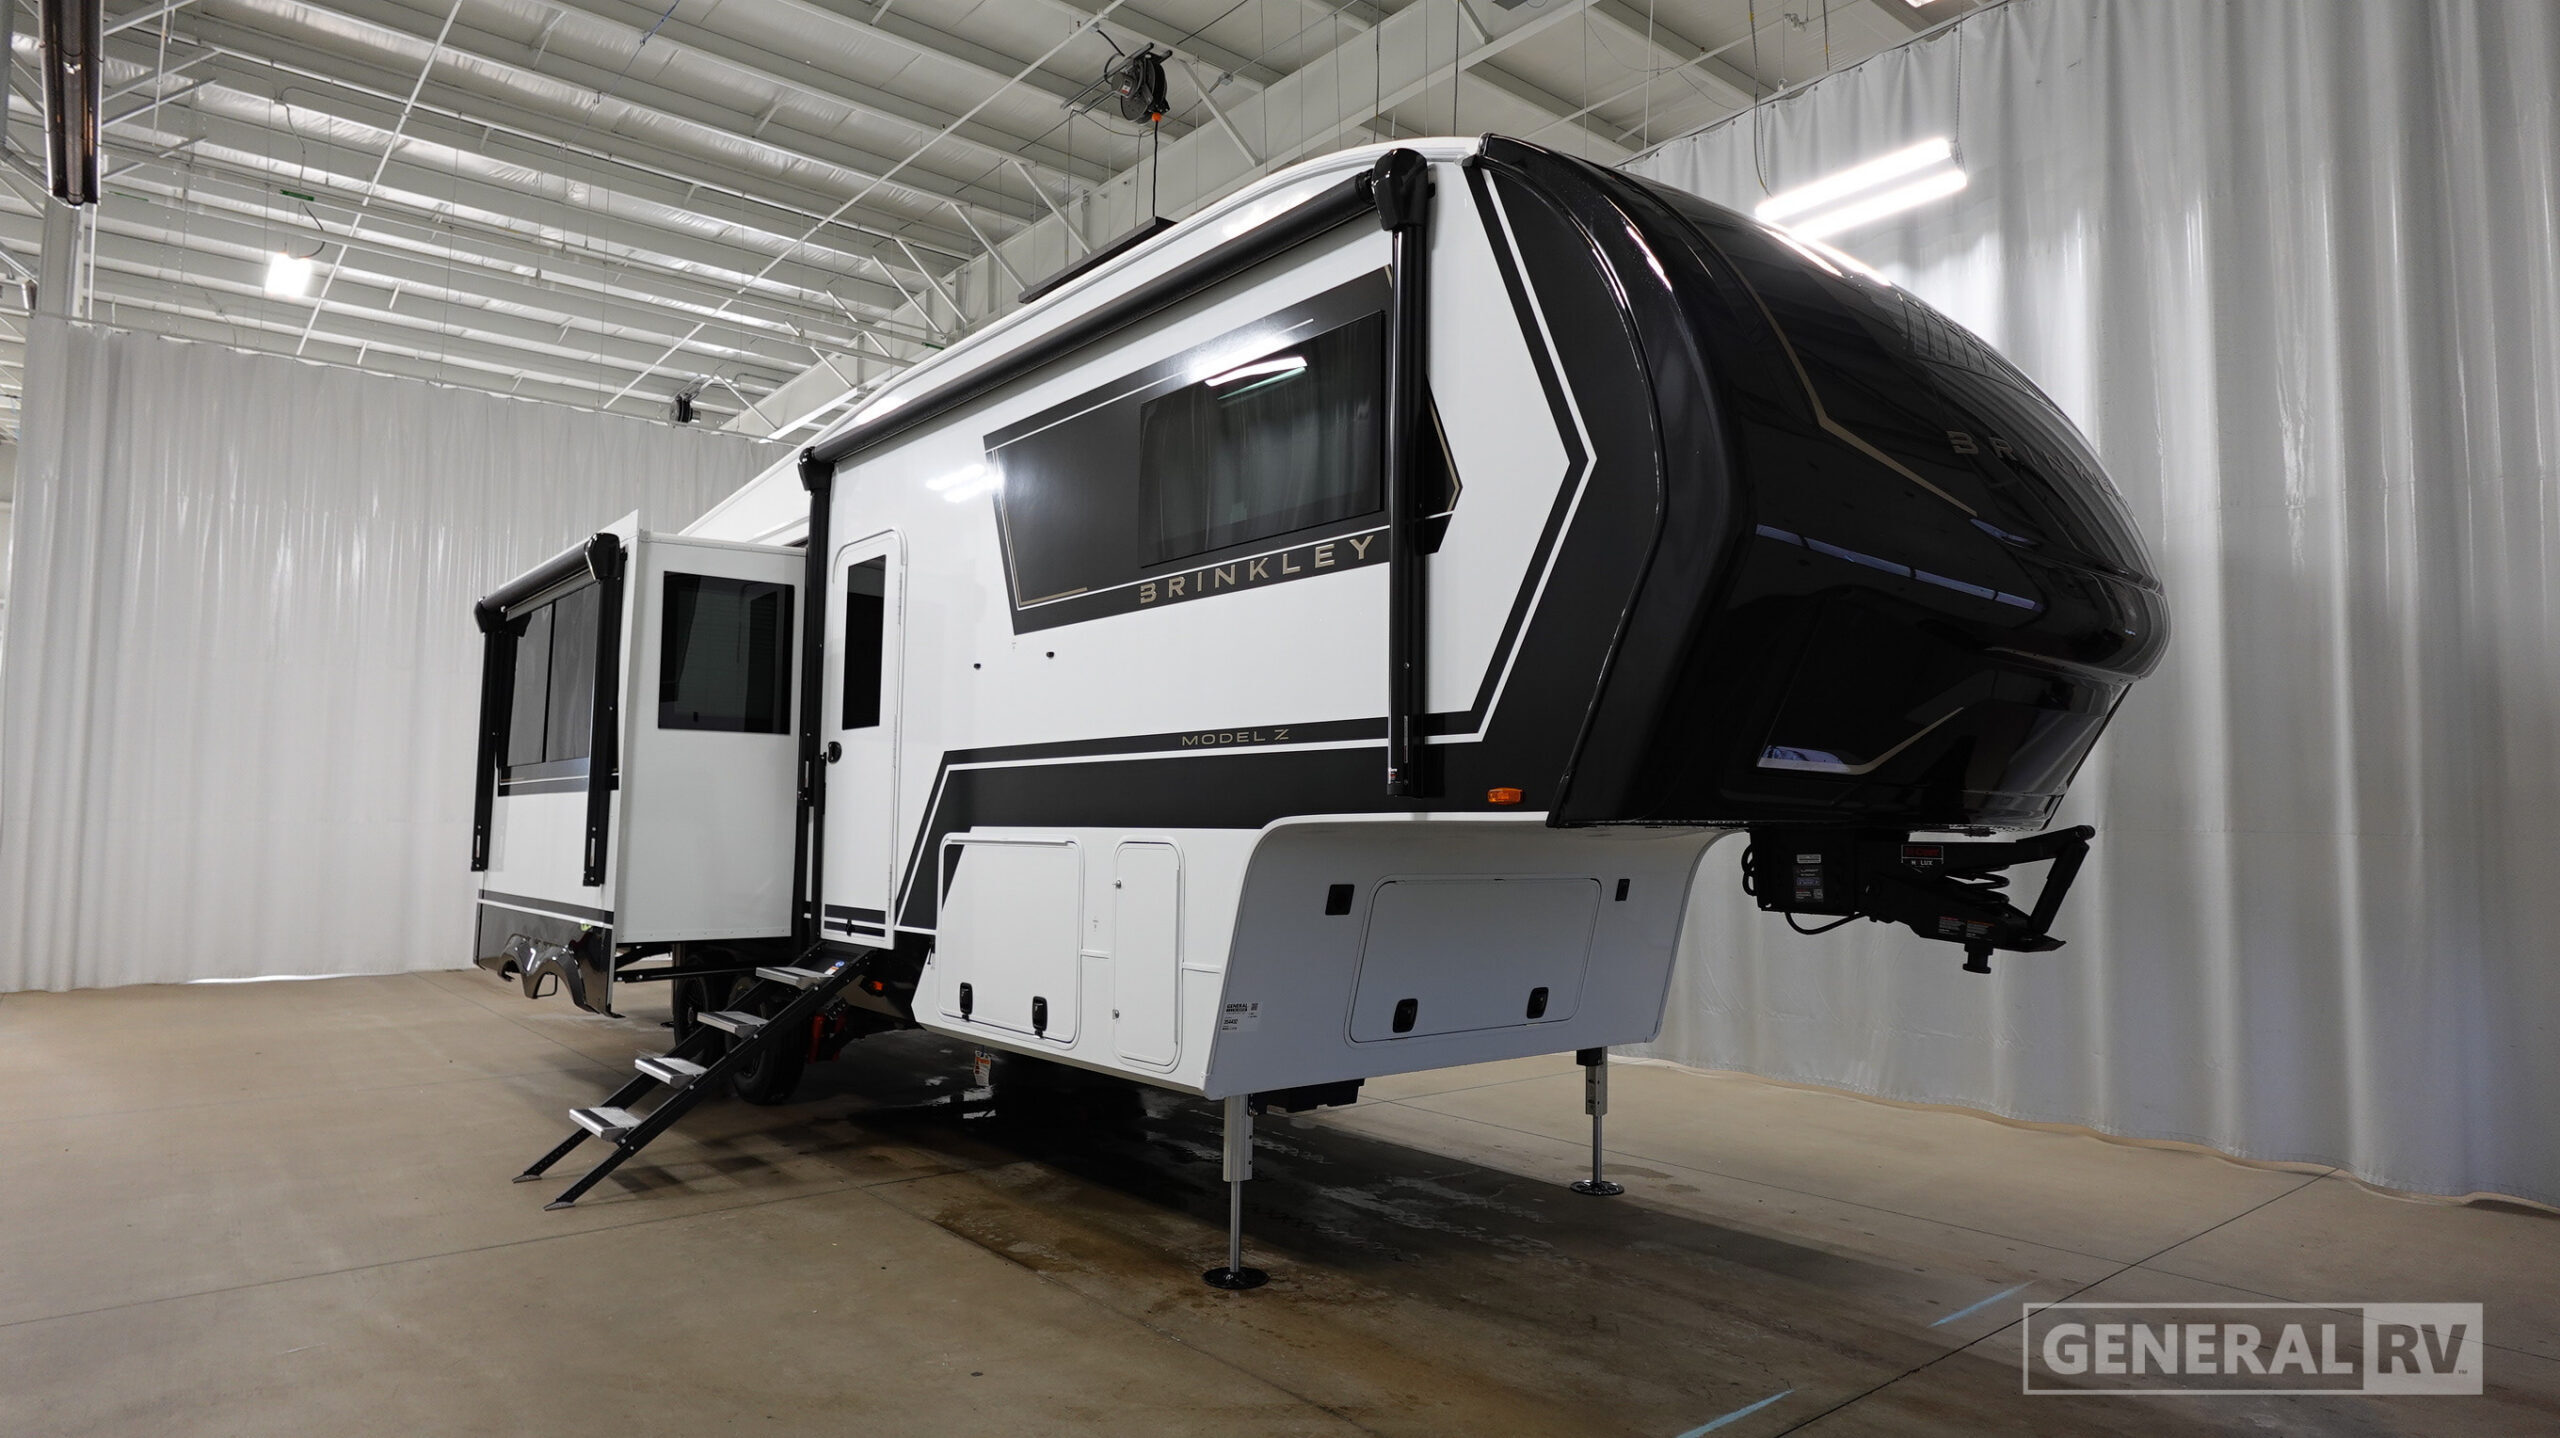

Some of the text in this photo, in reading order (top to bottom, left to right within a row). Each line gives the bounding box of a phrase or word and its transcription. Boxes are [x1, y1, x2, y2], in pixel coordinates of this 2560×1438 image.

[1140, 535, 1374, 604] BRINKLEY
[1181, 728, 1289, 746] MODEL Z
